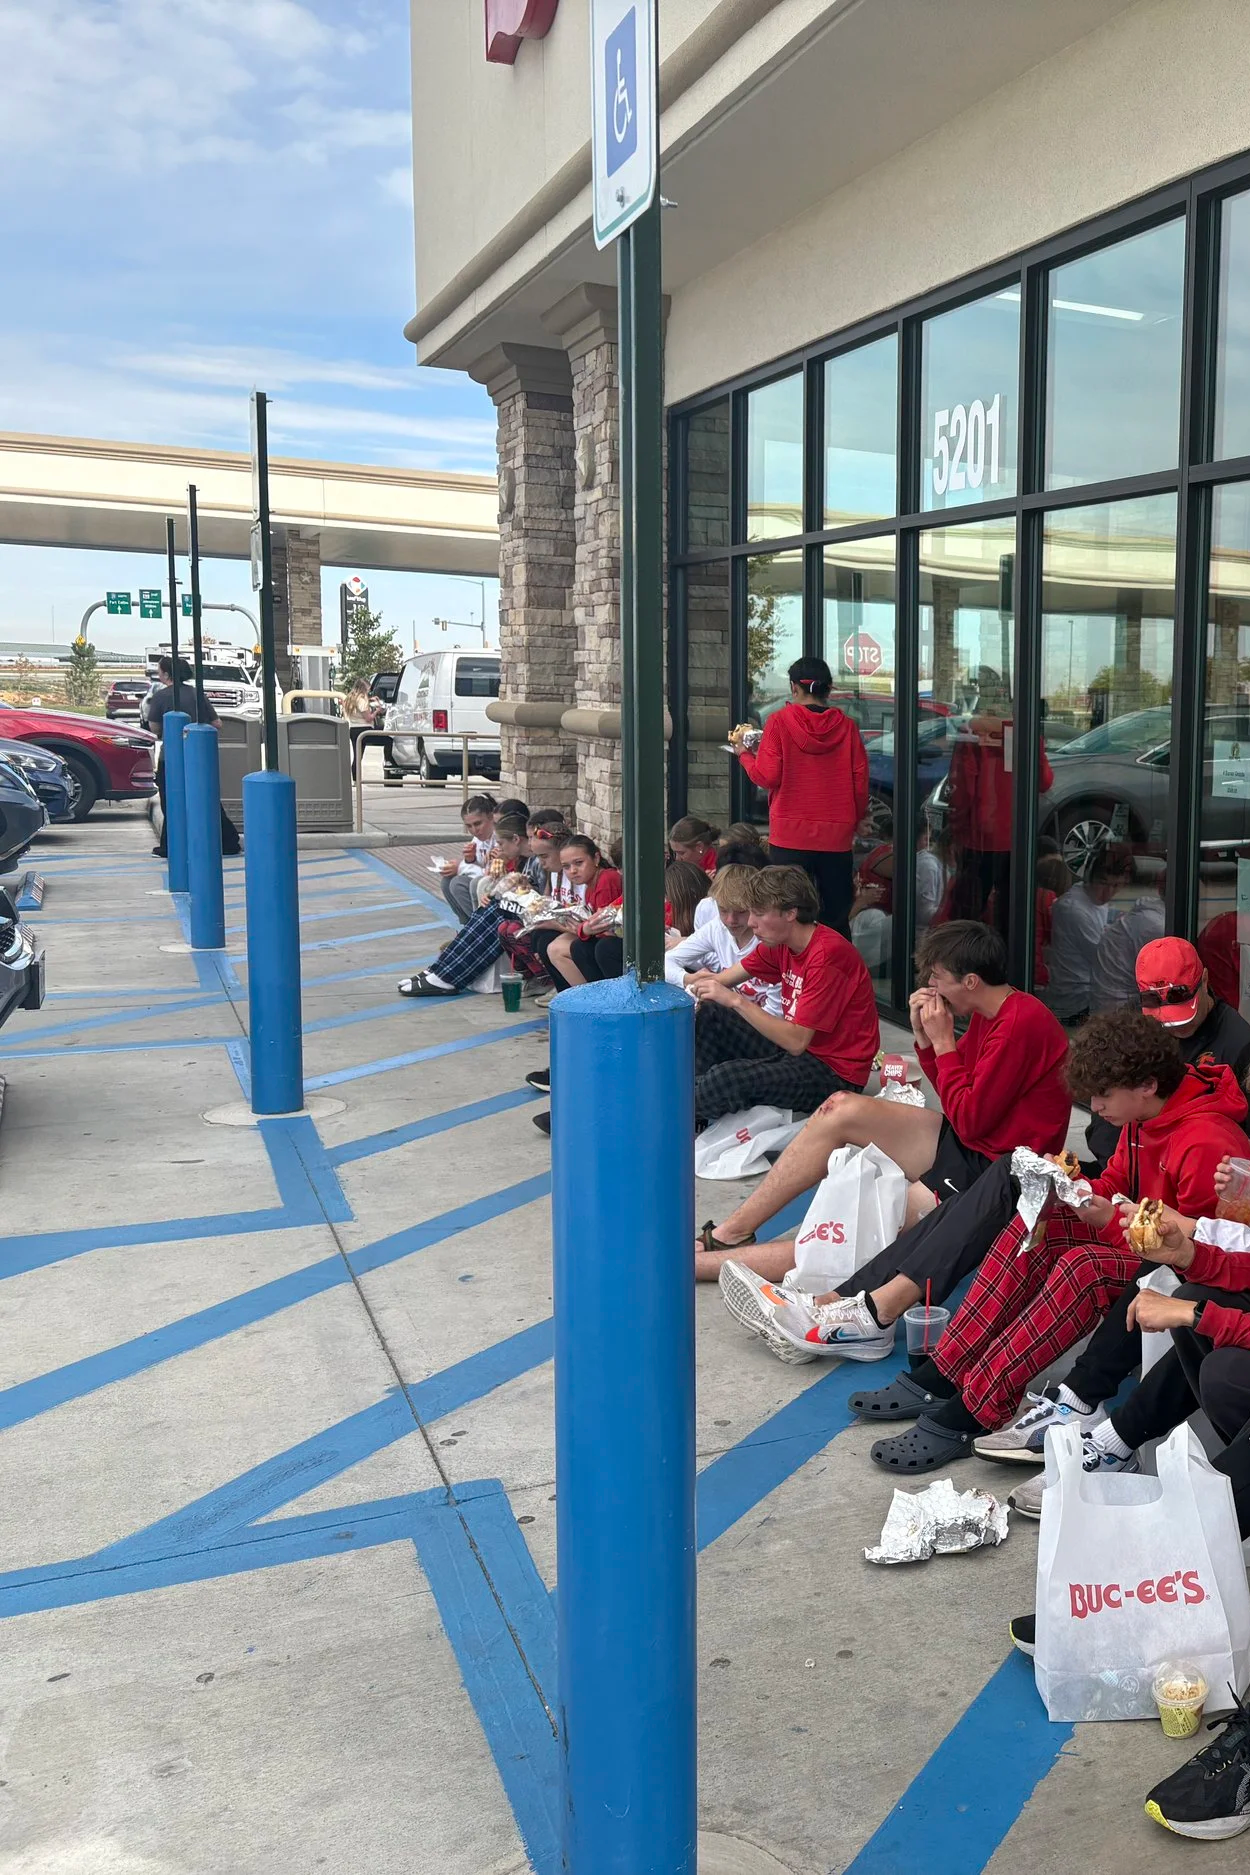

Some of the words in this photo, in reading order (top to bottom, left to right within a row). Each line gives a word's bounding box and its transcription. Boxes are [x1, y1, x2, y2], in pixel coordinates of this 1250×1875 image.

[932, 393, 1000, 495] 5201
[884, 1070, 903, 1078] CHIPS
[1069, 1570, 1205, 1619] BUC-EE'S
